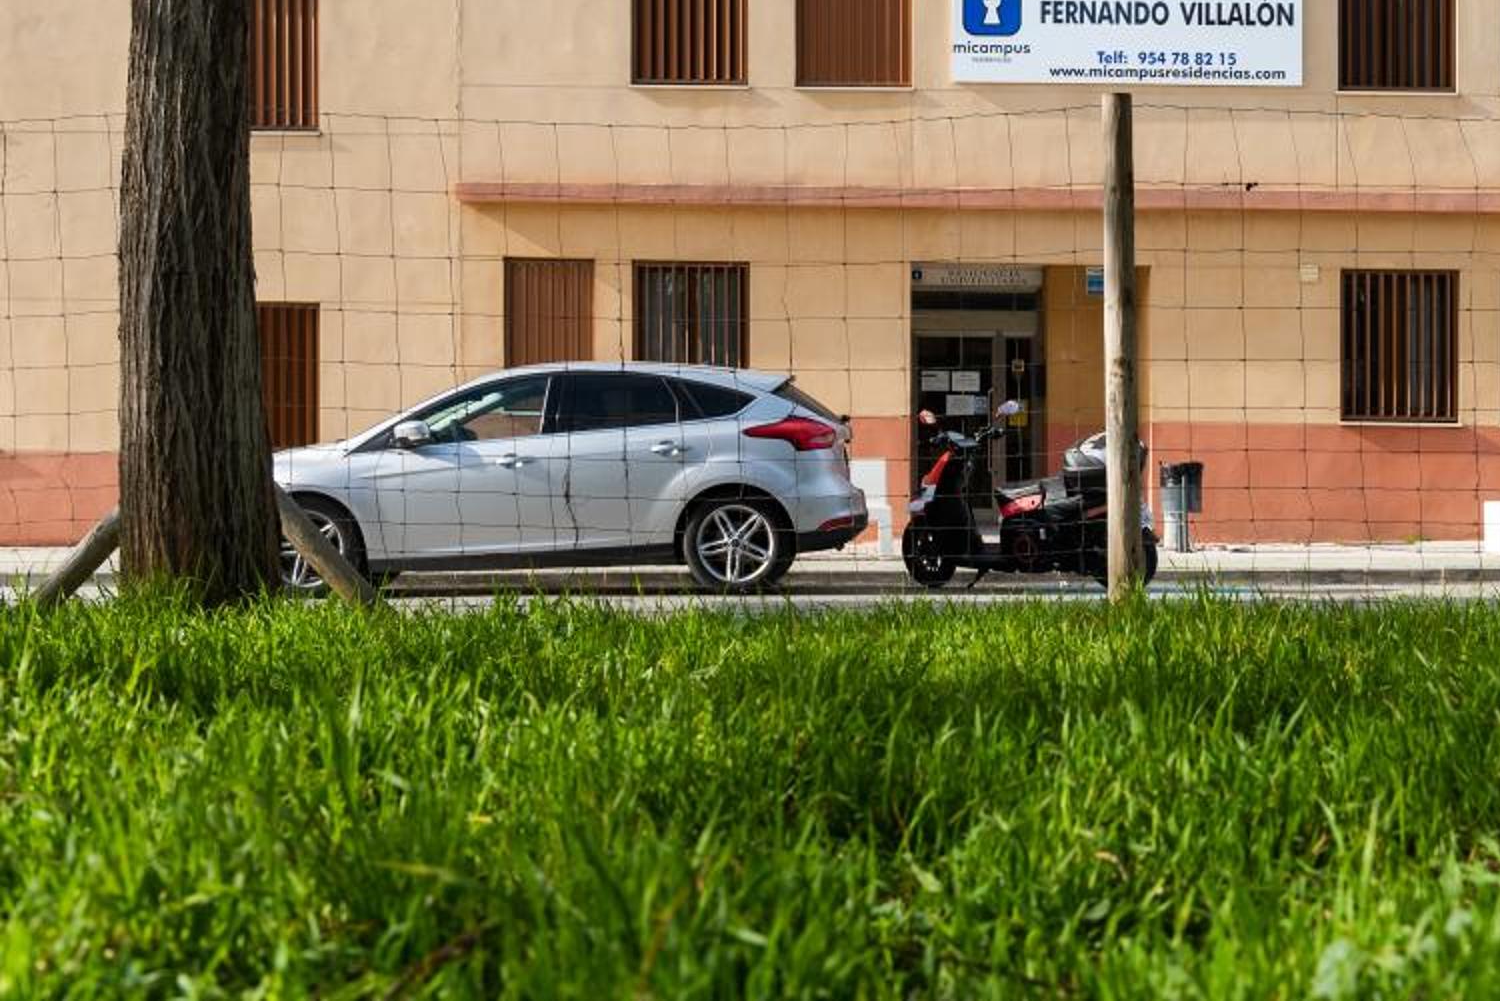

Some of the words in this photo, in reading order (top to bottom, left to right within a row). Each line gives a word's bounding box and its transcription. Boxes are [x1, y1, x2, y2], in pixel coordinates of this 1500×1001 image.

[1040, 1, 1170, 25] FERNANDO
[953, 40, 1031, 55] micampus
[1097, 51, 1128, 64] Telf:
[1138, 52, 1167, 65] 954
[1172, 52, 1190, 65] 78
[1195, 53, 1213, 66] 82
[1220, 53, 1237, 66] 15
[1049, 65, 1286, 81] www.micampusresidencias.com
